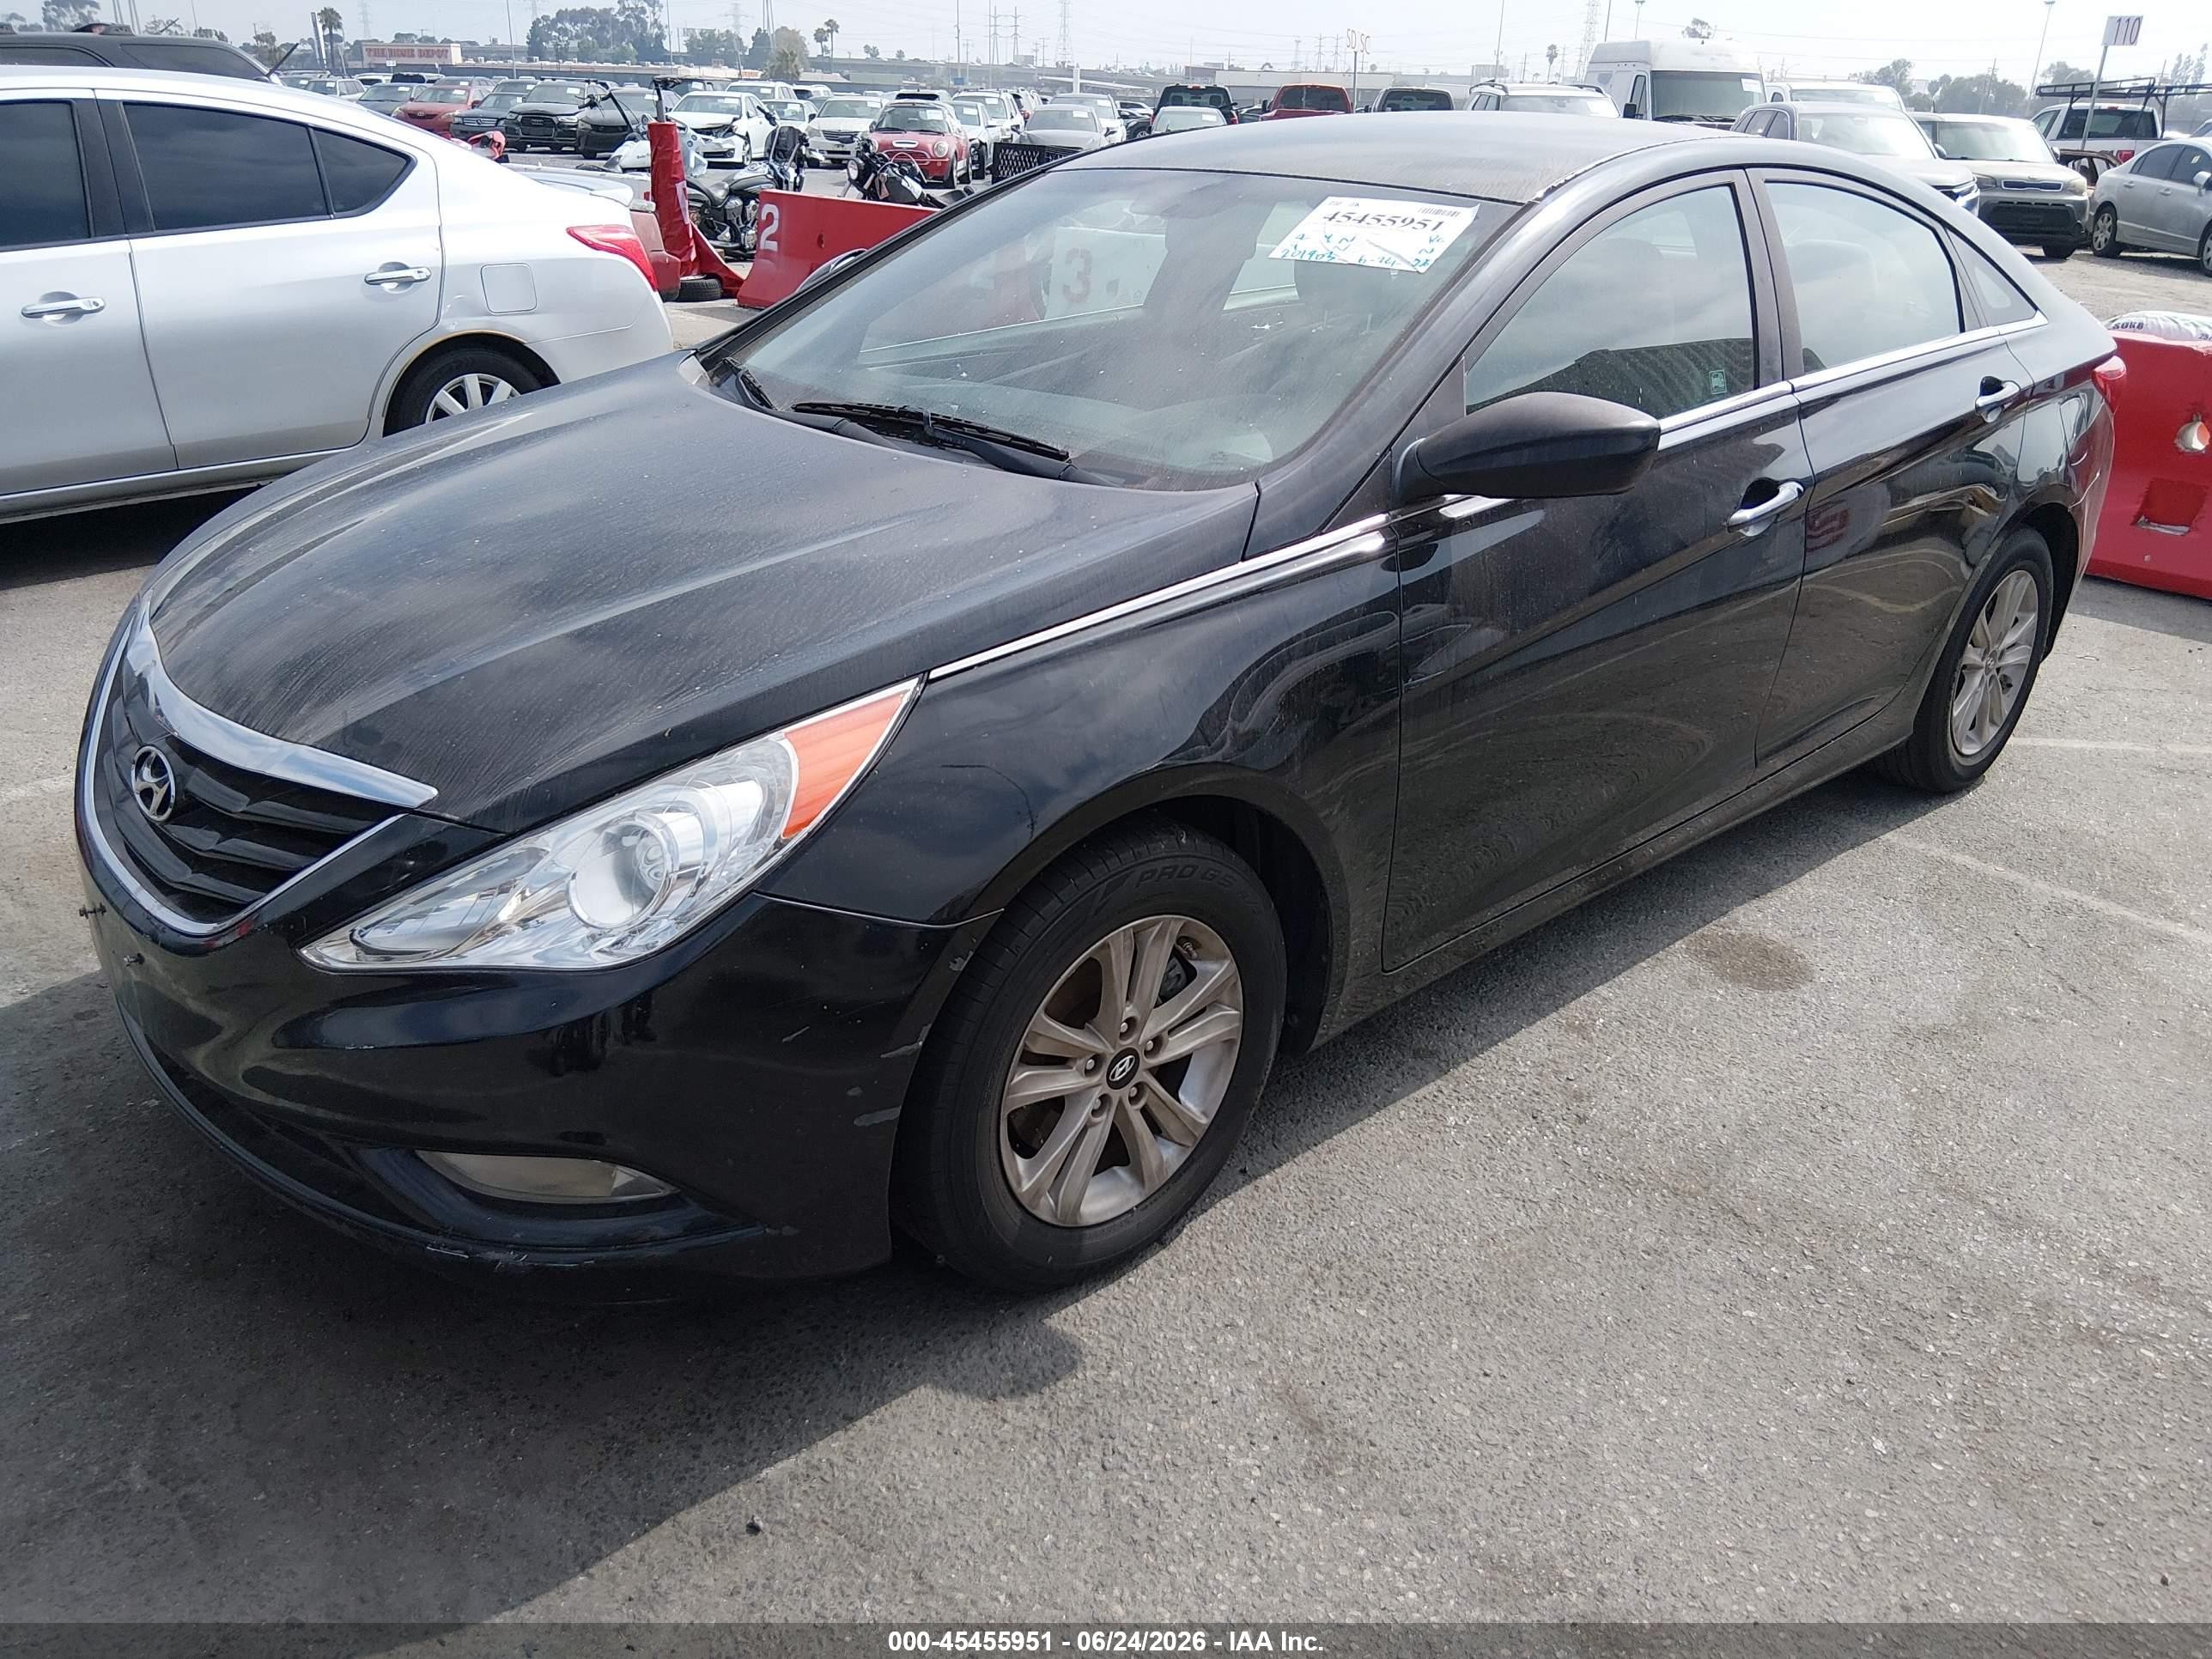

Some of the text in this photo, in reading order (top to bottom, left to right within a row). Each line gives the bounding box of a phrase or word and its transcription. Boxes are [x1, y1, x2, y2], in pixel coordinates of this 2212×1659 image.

[1346, 28, 1357, 50] SD
[2113, 17, 2141, 46] 110
[365, 47, 386, 58] THE
[417, 48, 449, 59] DEPOT
[1360, 33, 1370, 55] SC
[760, 204, 780, 252] 2
[1323, 210, 1444, 232] 45455951
[1062, 246, 1093, 304] 3
